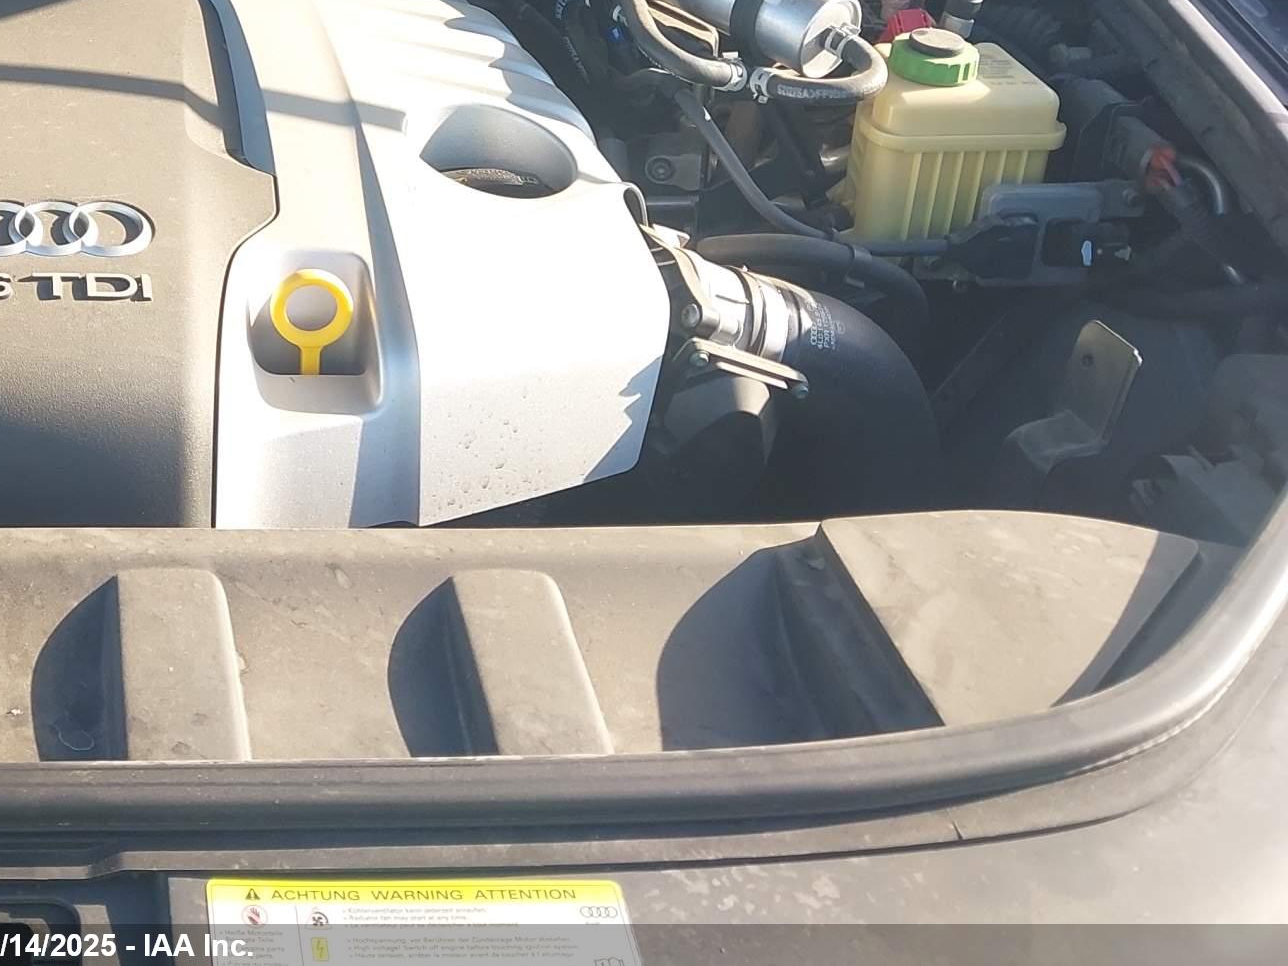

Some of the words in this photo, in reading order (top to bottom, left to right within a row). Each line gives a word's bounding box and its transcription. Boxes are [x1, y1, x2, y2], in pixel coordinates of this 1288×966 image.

[31, 273, 152, 301] TDI
[271, 890, 360, 901] ACHTUNG
[371, 889, 463, 901] WARNING
[474, 889, 577, 900] ATTENTION
